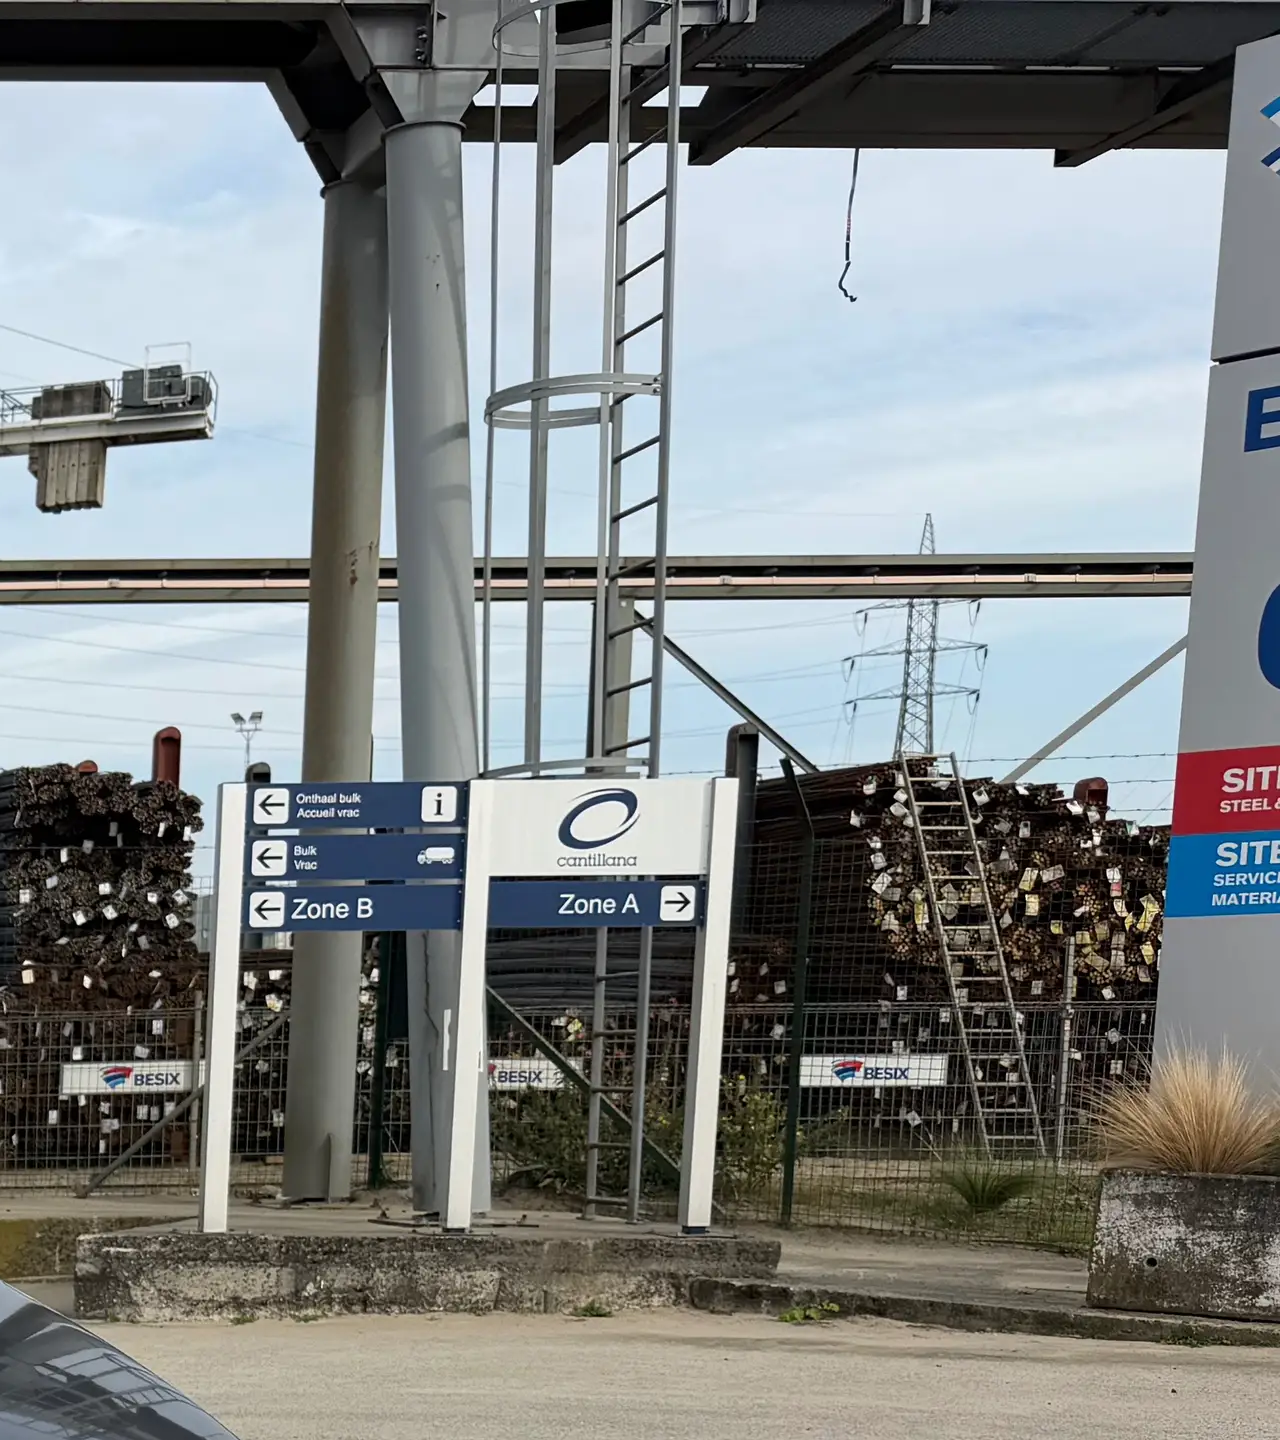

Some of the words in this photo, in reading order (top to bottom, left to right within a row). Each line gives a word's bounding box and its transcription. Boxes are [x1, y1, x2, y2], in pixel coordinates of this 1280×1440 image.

[1221, 764, 1280, 793] SIT
[339, 792, 362, 804] bulk
[1219, 798, 1272, 813] STEEL
[296, 808, 335, 818] Accueil
[337, 809, 360, 818] vrac
[294, 845, 318, 856] Bulk
[294, 860, 318, 870] Vrac
[557, 853, 638, 868] cantillana
[291, 898, 350, 920] Zone
[357, 897, 374, 919] B
[558, 893, 617, 915] Zone
[621, 893, 640, 914] A
[133, 1072, 181, 1086] BESIX
[497, 1070, 543, 1083] BESIX
[864, 1067, 910, 1080] BESIX
